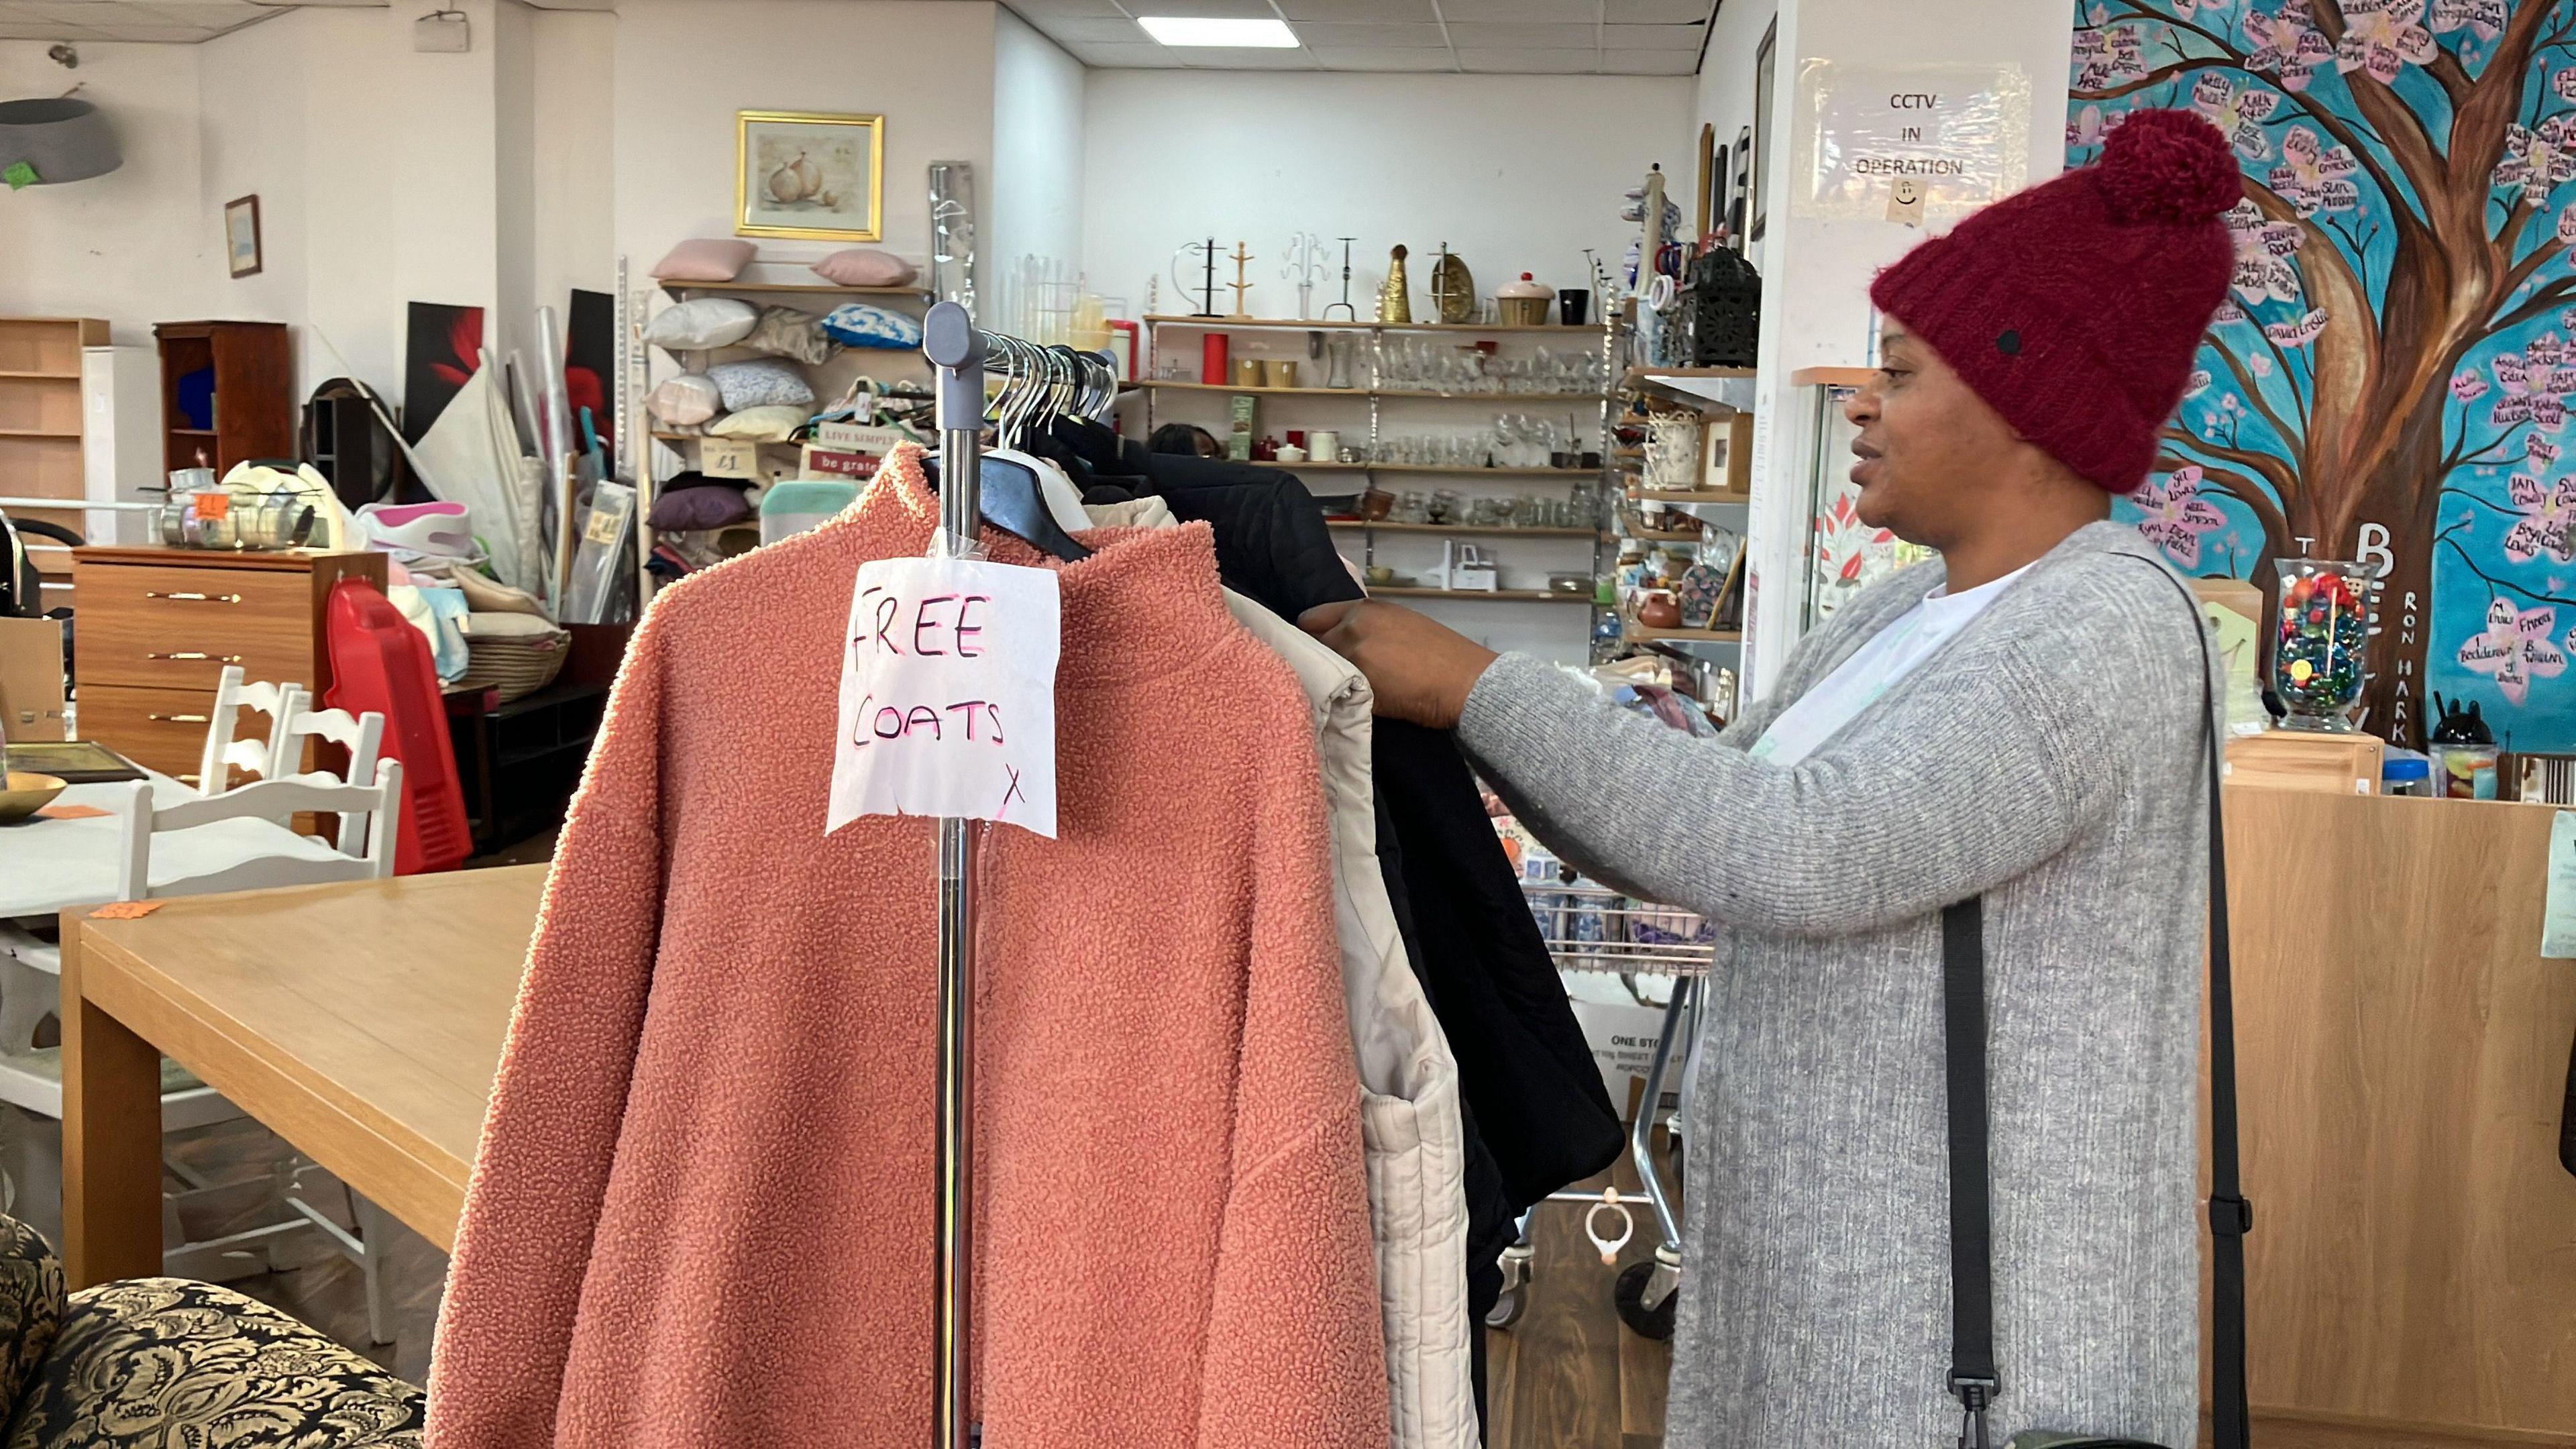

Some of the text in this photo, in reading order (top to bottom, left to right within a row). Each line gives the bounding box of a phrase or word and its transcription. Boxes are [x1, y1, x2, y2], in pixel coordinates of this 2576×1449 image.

[1890, 94, 1937, 109] CCTV
[1902, 127, 1921, 142] IN
[1856, 159, 1963, 174] OPERATION
[825, 431, 849, 441] LIVE
[821, 455, 880, 473] be grate
[2401, 591, 2418, 645] RON
[853, 586, 990, 672] FREE
[853, 694, 1005, 749] COATS
[1611, 1035, 1636, 1046] ONE
